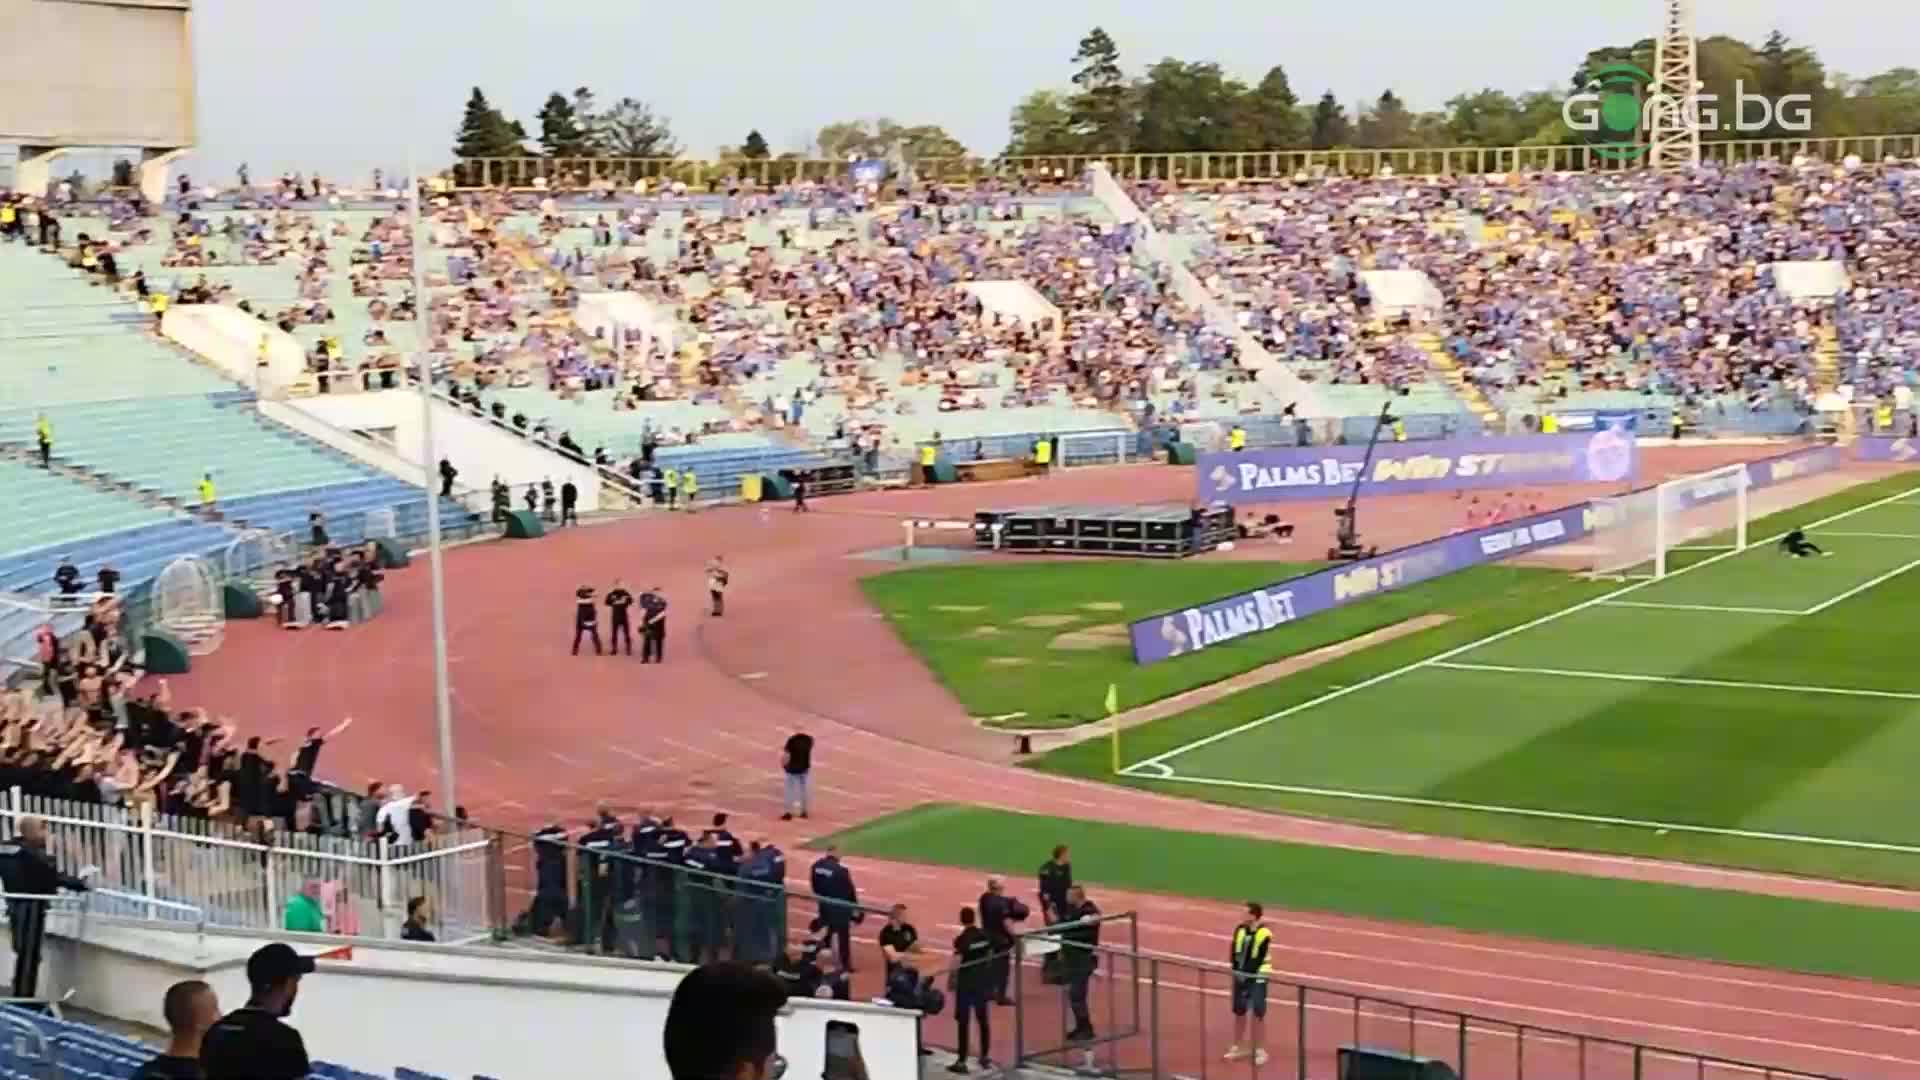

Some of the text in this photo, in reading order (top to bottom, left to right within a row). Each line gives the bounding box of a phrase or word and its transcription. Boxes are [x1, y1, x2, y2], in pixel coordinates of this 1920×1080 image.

[1238, 463, 1321, 490] PALMS
[1183, 601, 1260, 650] PALMS
[1252, 589, 1297, 629] BET
